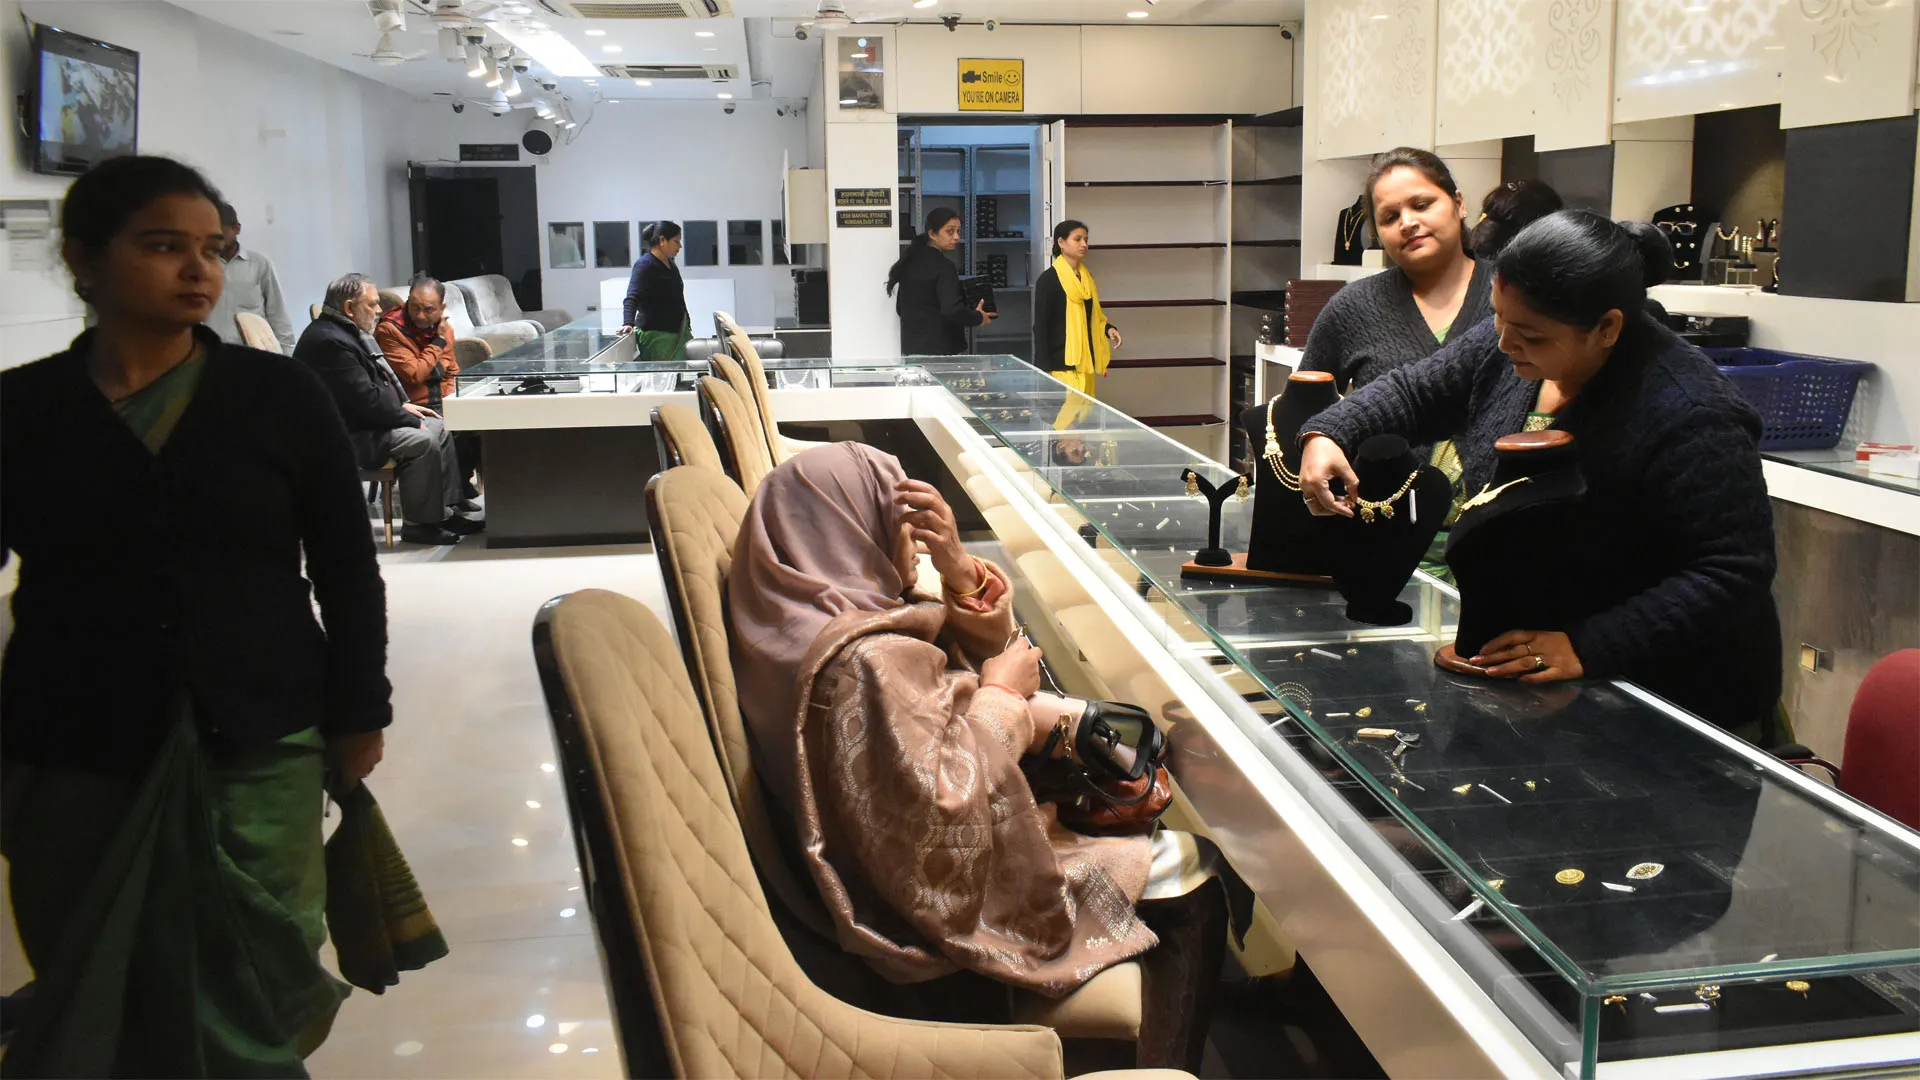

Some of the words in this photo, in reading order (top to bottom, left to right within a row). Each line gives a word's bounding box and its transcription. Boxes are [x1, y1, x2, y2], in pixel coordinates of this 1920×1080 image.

[982, 71, 1003, 84] Smile
[963, 91, 984, 103] YOU'RE
[985, 91, 994, 103] ON
[995, 91, 1020, 104] CAMERA
